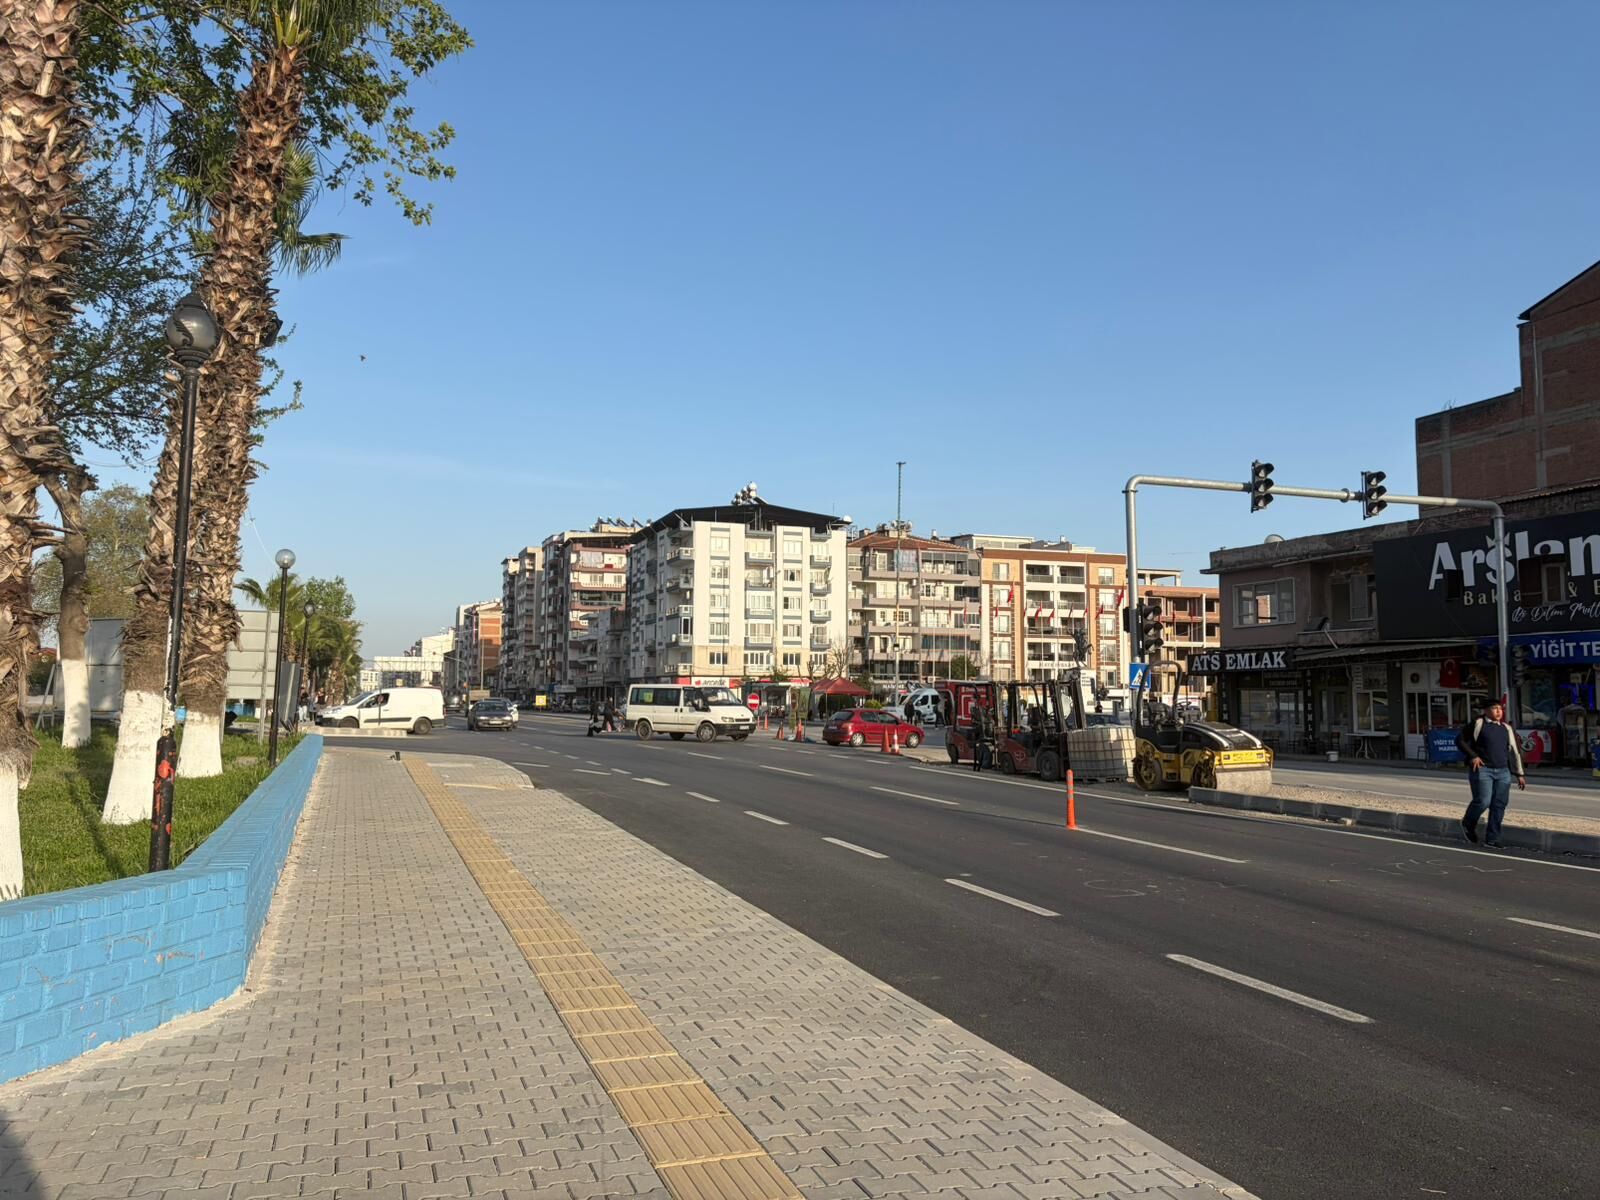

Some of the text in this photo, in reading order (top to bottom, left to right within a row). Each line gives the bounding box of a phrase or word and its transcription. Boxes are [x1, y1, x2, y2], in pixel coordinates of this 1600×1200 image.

[1568, 581, 1577, 597] &
[1530, 638, 1576, 658] YİĞİT
[1191, 651, 1287, 671] ATS EMLAK
